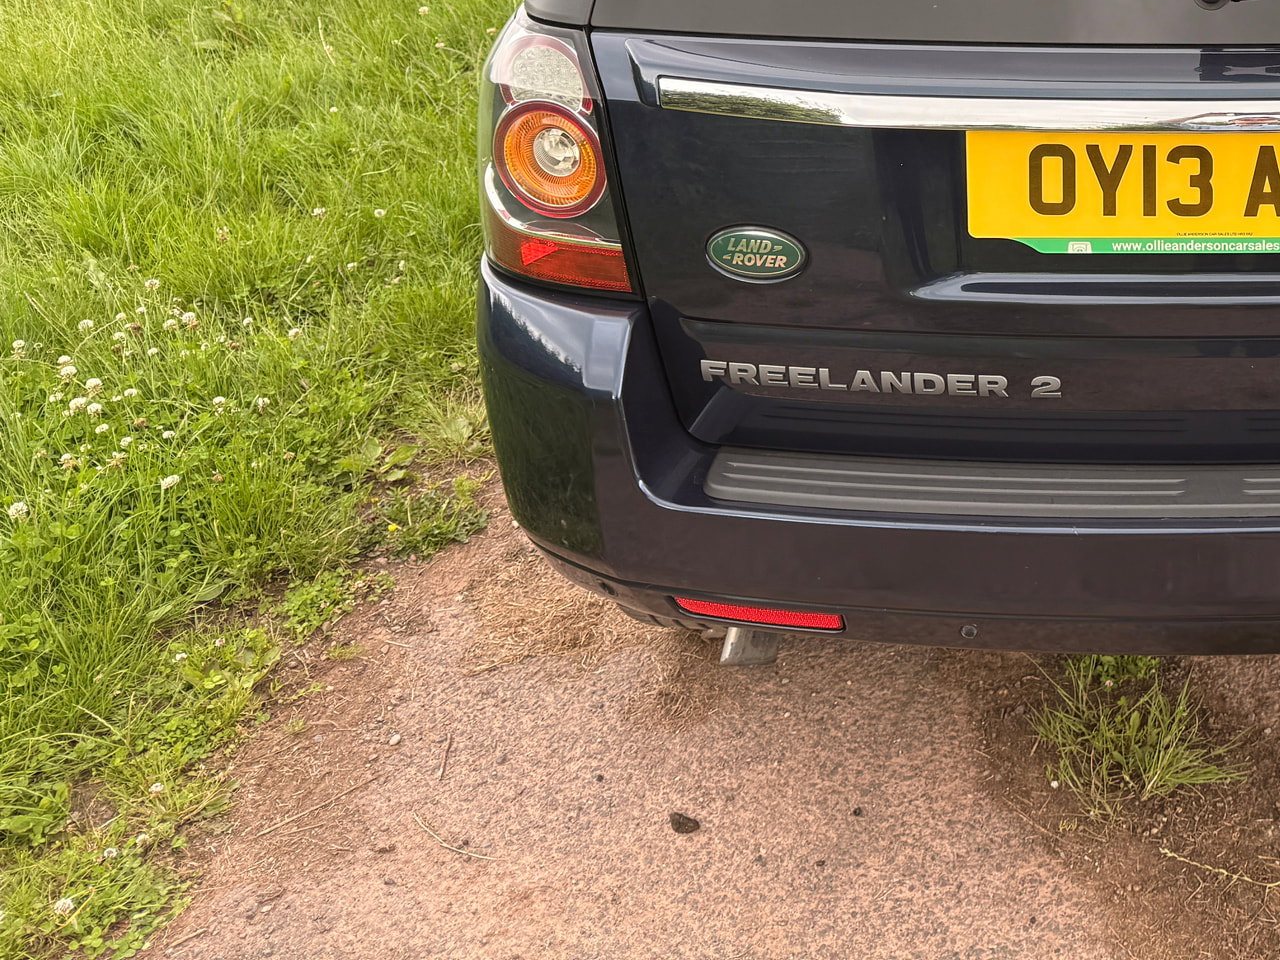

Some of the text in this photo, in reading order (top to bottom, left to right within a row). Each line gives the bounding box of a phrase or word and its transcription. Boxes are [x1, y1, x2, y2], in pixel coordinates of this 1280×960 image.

[1028, 143, 1214, 217] OY13
[727, 238, 772, 253] LAND
[732, 253, 787, 268] ROVER
[700, 359, 1062, 398] FREELANDER 2
